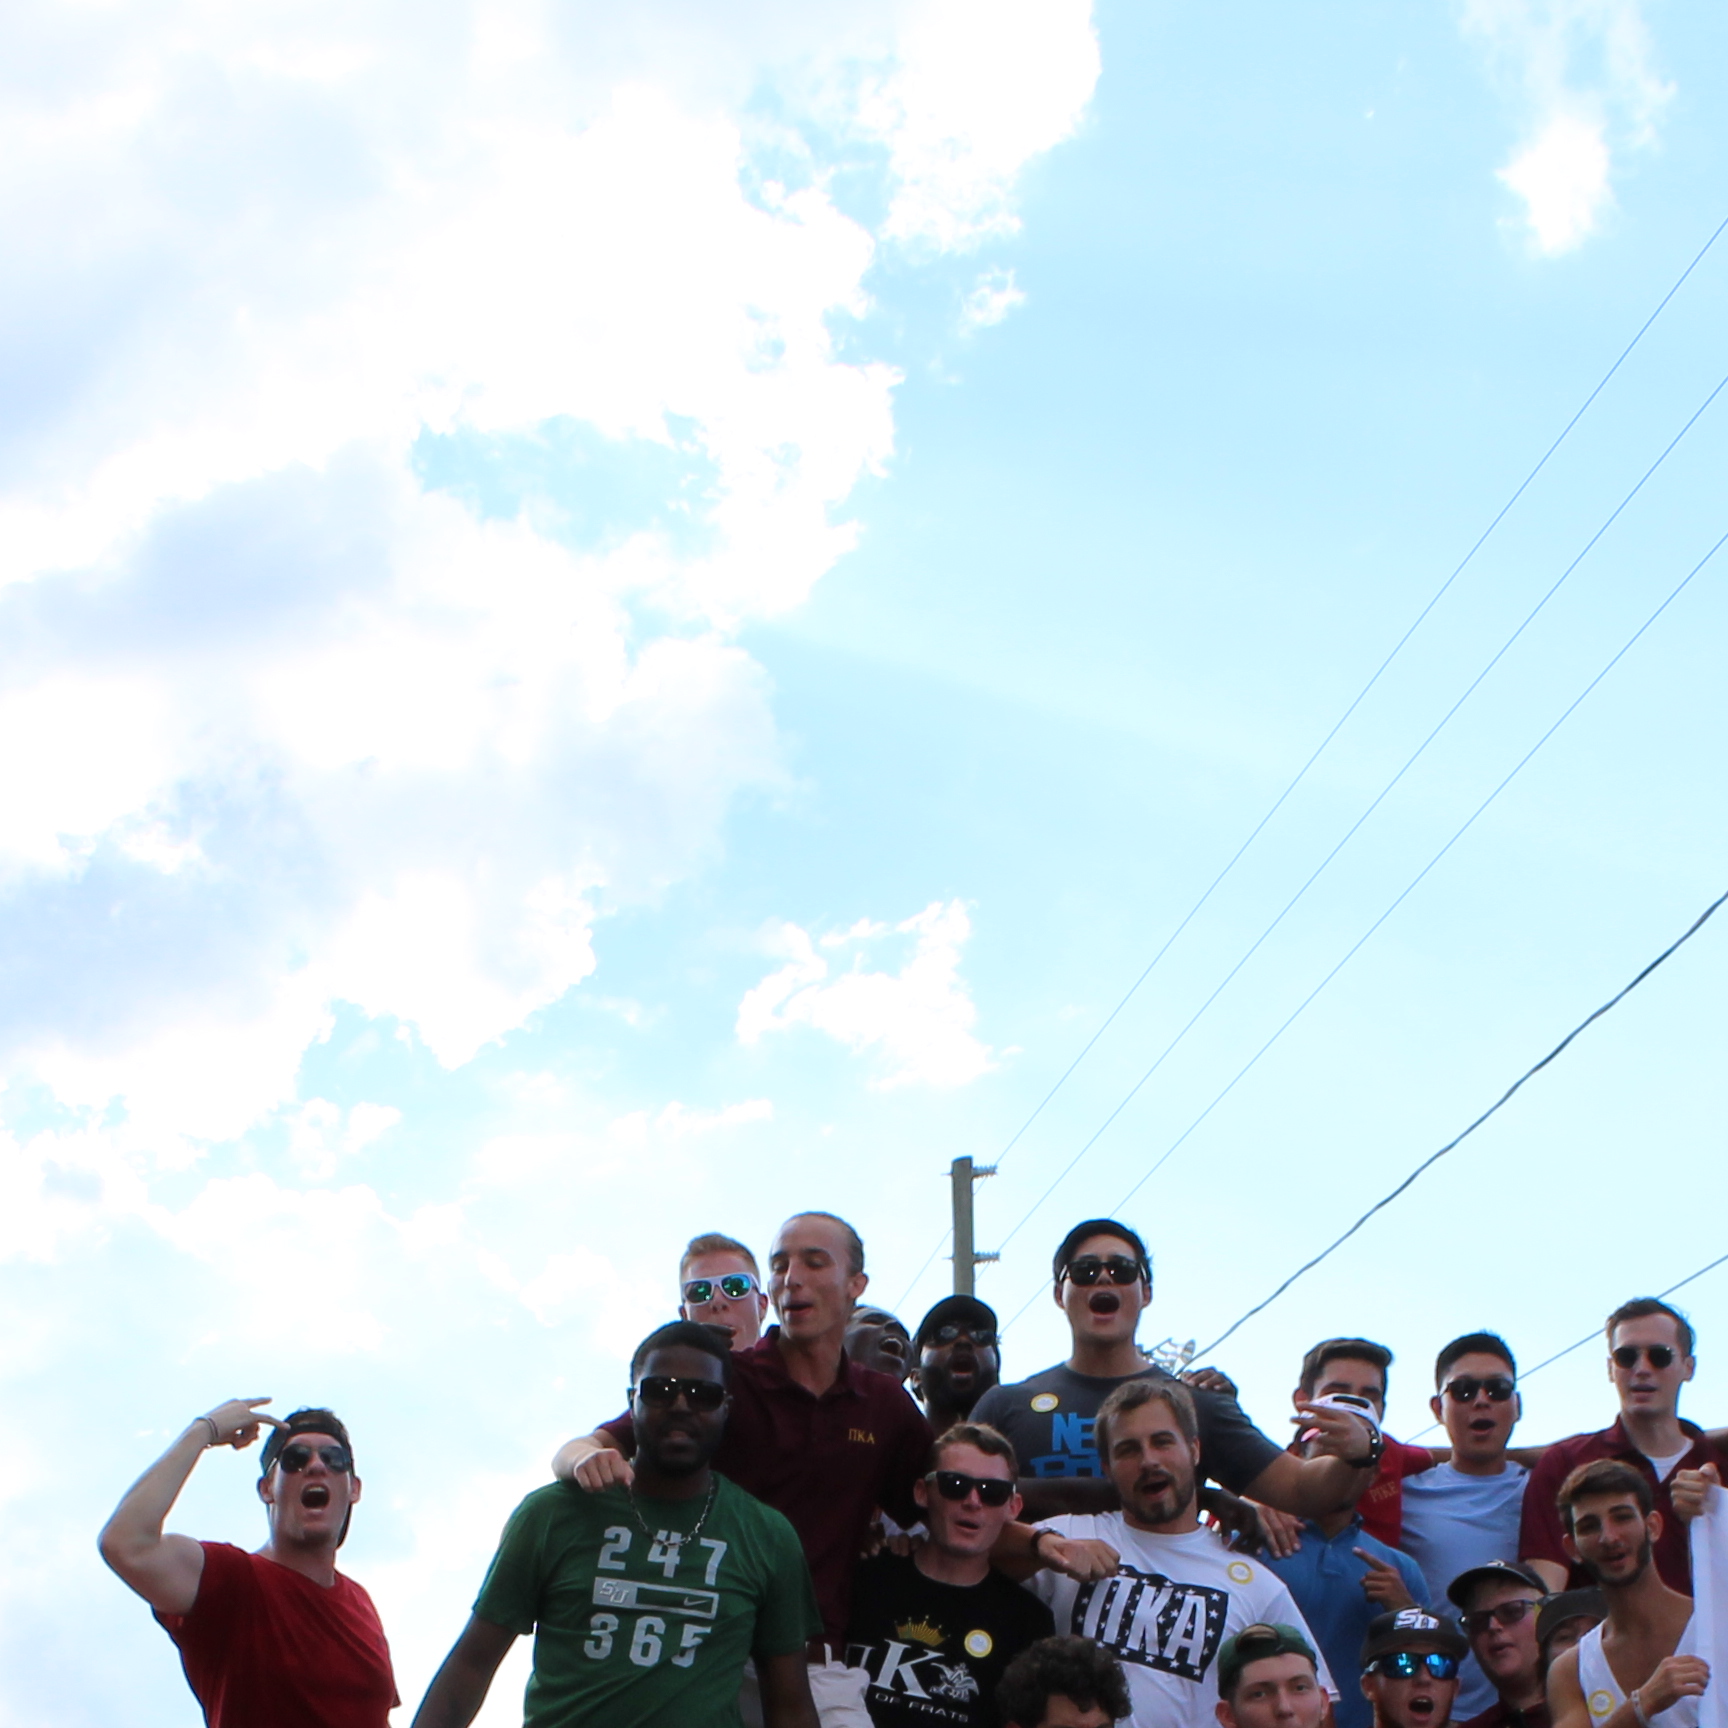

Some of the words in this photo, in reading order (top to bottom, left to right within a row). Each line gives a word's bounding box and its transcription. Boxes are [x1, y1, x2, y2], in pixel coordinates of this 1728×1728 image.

[1052, 1412, 1098, 1455] NE
[875, 1692, 901, 1704] OF
[908, 1701, 969, 1723] FRATS
